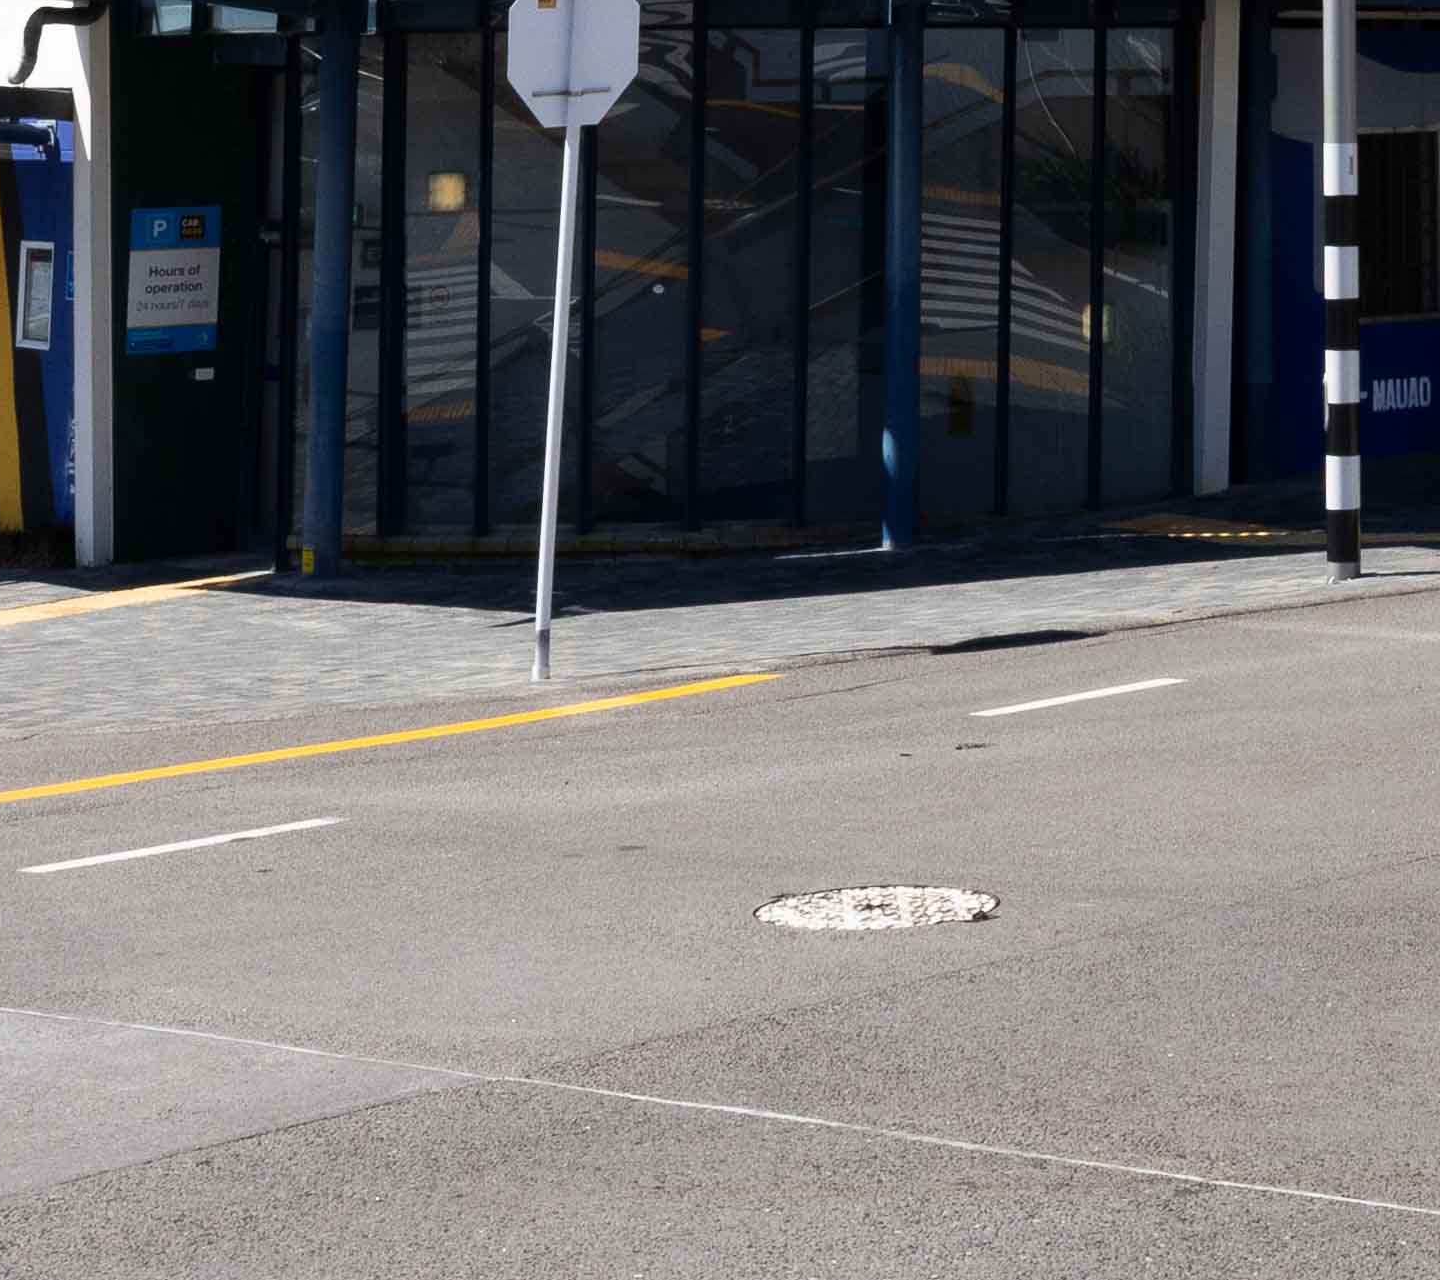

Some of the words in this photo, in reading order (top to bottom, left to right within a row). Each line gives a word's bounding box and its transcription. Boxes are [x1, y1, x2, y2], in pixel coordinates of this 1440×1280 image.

[153, 219, 168, 238] P
[148, 266, 185, 279] Hours
[187, 264, 201, 277] of
[144, 280, 203, 295] operation
[1372, 376, 1431, 412] MAUAO
